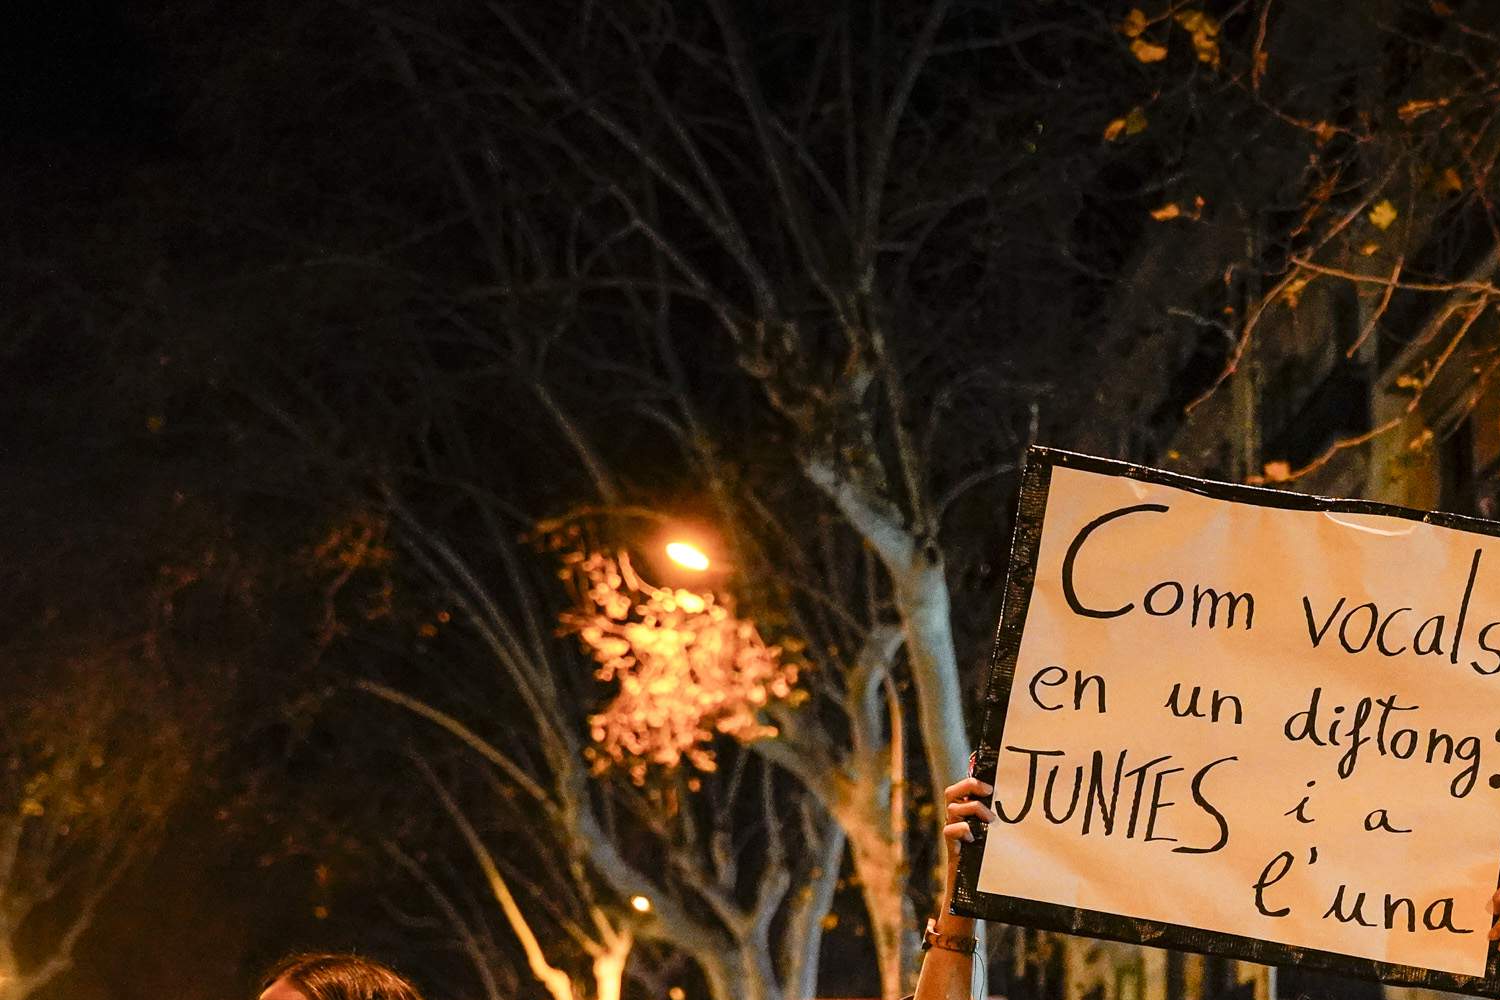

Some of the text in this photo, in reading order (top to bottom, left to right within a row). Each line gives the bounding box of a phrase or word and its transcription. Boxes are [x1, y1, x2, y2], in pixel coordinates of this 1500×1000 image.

[1061, 503, 1255, 631] Com
[1028, 665, 1107, 714] en
[1165, 681, 1244, 726] un
[994, 744, 1413, 854] JUNTES i a
[1252, 846, 1474, 935] l'una
